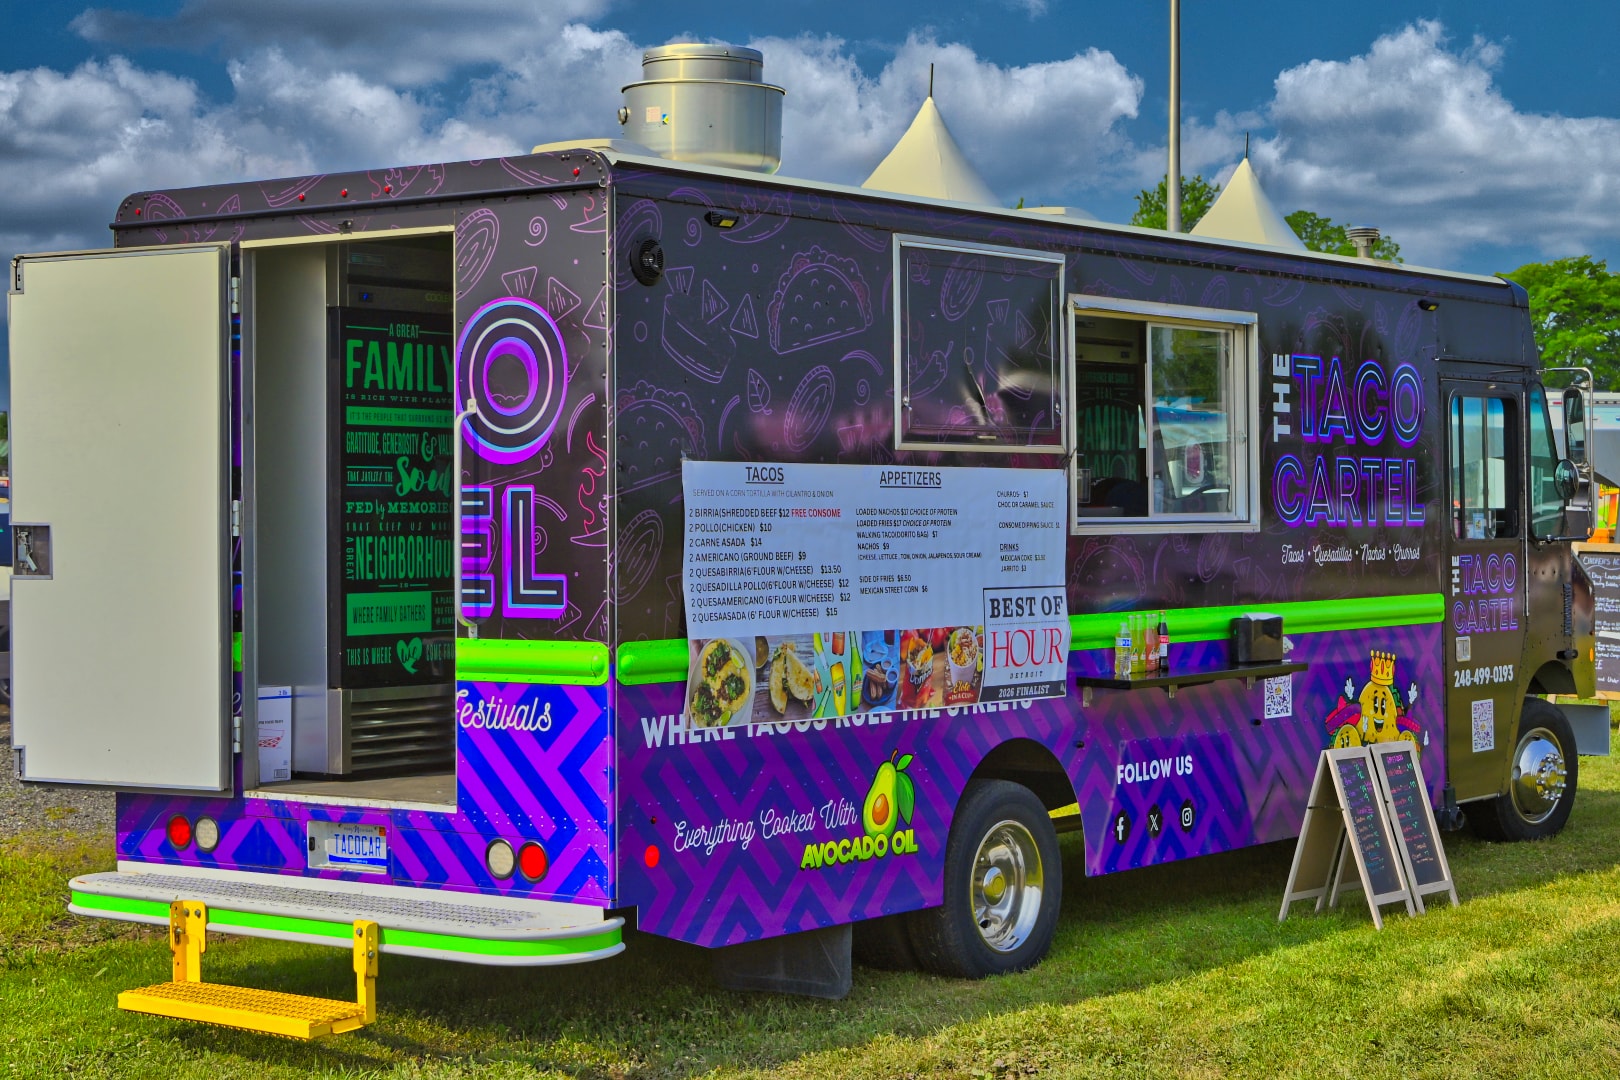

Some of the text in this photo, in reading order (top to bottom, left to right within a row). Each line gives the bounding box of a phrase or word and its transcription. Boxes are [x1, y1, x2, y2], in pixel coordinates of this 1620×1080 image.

[389, 323, 419, 338] A GREAT
[347, 339, 454, 392] FAMILY
[1273, 354, 1290, 442] THE
[1292, 353, 1424, 448] TACO
[383, 433, 418, 454] GENEROSITY
[746, 467, 784, 482] TACOS
[880, 471, 941, 485] APPETIZERS
[1272, 454, 1426, 528] CARTEL
[346, 502, 373, 513] FED
[761, 509, 777, 517] BEEF
[779, 508, 789, 517] $12
[792, 509, 806, 517] FREE
[809, 509, 840, 517] CONSOME
[689, 524, 693, 532] 2
[760, 523, 772, 532] $10
[689, 538, 762, 547] 2 CARNE ASADA $14
[356, 536, 454, 580] NEIGHBORHOO
[690, 552, 806, 562] 2 AMERICANO (GROUND BEEF) $9
[1282, 544, 1420, 566] Tacos Quesadillas Nachos Churros
[690, 565, 841, 577] 2 W/CHEESE) $13.50
[1460, 553, 1516, 594] TACO
[690, 584, 694, 592] 2
[696, 583, 742, 593] QUESADILLA
[799, 579, 834, 590] W/CHEESE)
[839, 579, 849, 588] $12
[692, 599, 695, 607] 2
[697, 596, 764, 608] QUESAAMERICANO
[799, 594, 834, 604] W/CHEESE)
[840, 593, 851, 602] $12
[990, 596, 1063, 618] BEST OF
[353, 606, 374, 624] WHERE
[376, 605, 398, 623] FAMILY
[400, 605, 425, 622] GATHERS
[693, 614, 696, 622] 2
[698, 610, 746, 623] QUESAASADA
[758, 610, 780, 619] FLOUR
[783, 608, 819, 618] W/CHEESE)
[826, 608, 837, 616] $15
[1454, 598, 1518, 634] CARTEL
[347, 647, 391, 666] THIS IS WHERE
[991, 628, 1063, 669] HOUR
[1010, 671, 1043, 680] DETROIT
[1454, 665, 1513, 688] 248-499-0193
[953, 681, 970, 693] Elote
[999, 685, 1050, 698] 2026 FINALIST
[1117, 755, 1193, 784] FOLLOW US
[674, 798, 858, 855] Everything Cooked With
[334, 834, 381, 856] TACOCAR
[801, 829, 918, 869] AVOCADO OIL
